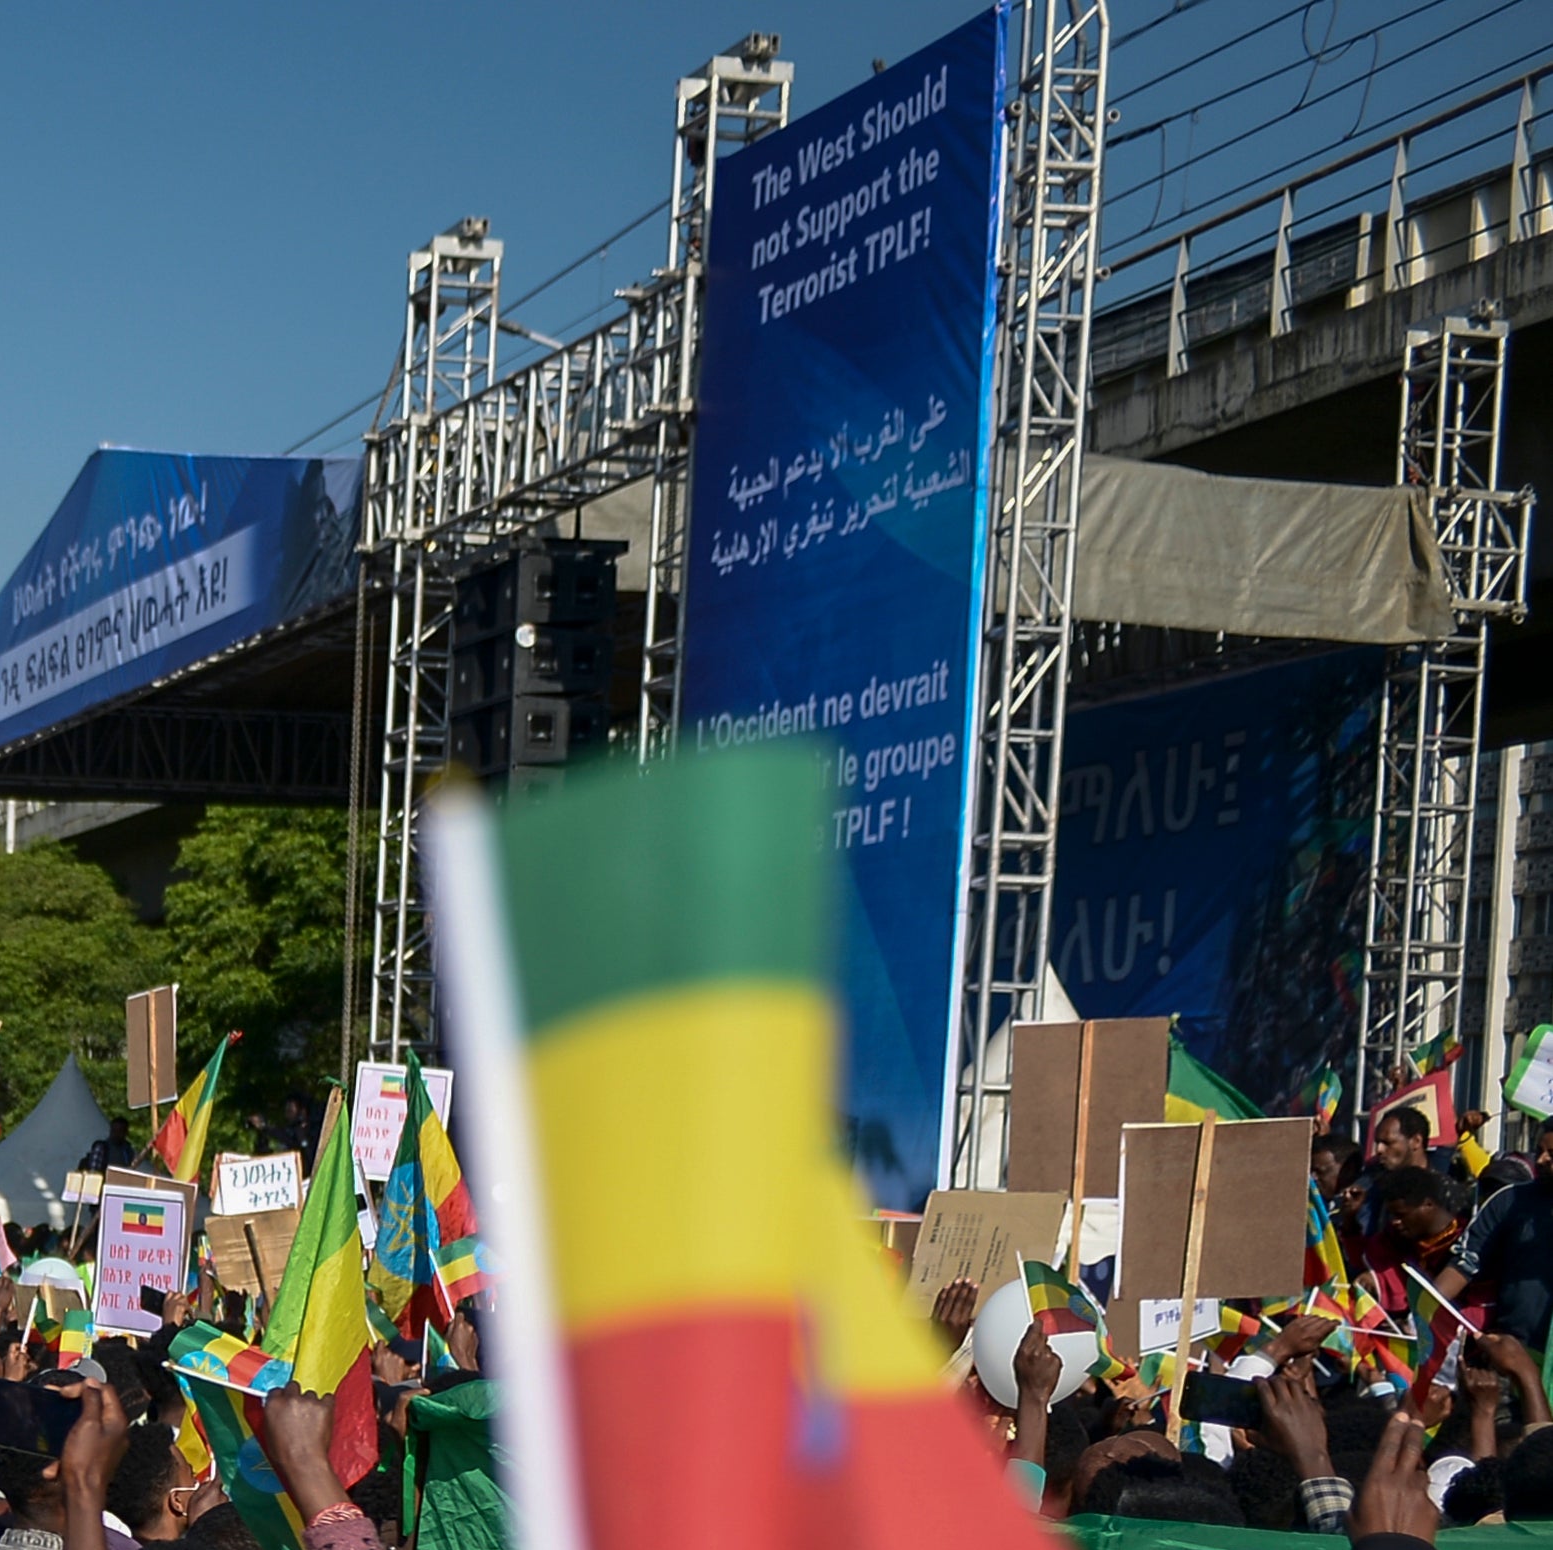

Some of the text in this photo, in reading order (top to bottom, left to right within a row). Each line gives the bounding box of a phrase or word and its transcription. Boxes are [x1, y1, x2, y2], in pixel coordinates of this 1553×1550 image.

[752, 65, 947, 210] The West Should
[751, 147, 939, 270] not Support the
[759, 206, 931, 324] Terrorist TPLF!
[697, 659, 949, 754] L'Occident ne devrait
[837, 747, 857, 786] le
[864, 732, 956, 792] groupe
[832, 799, 896, 850] TPLF
